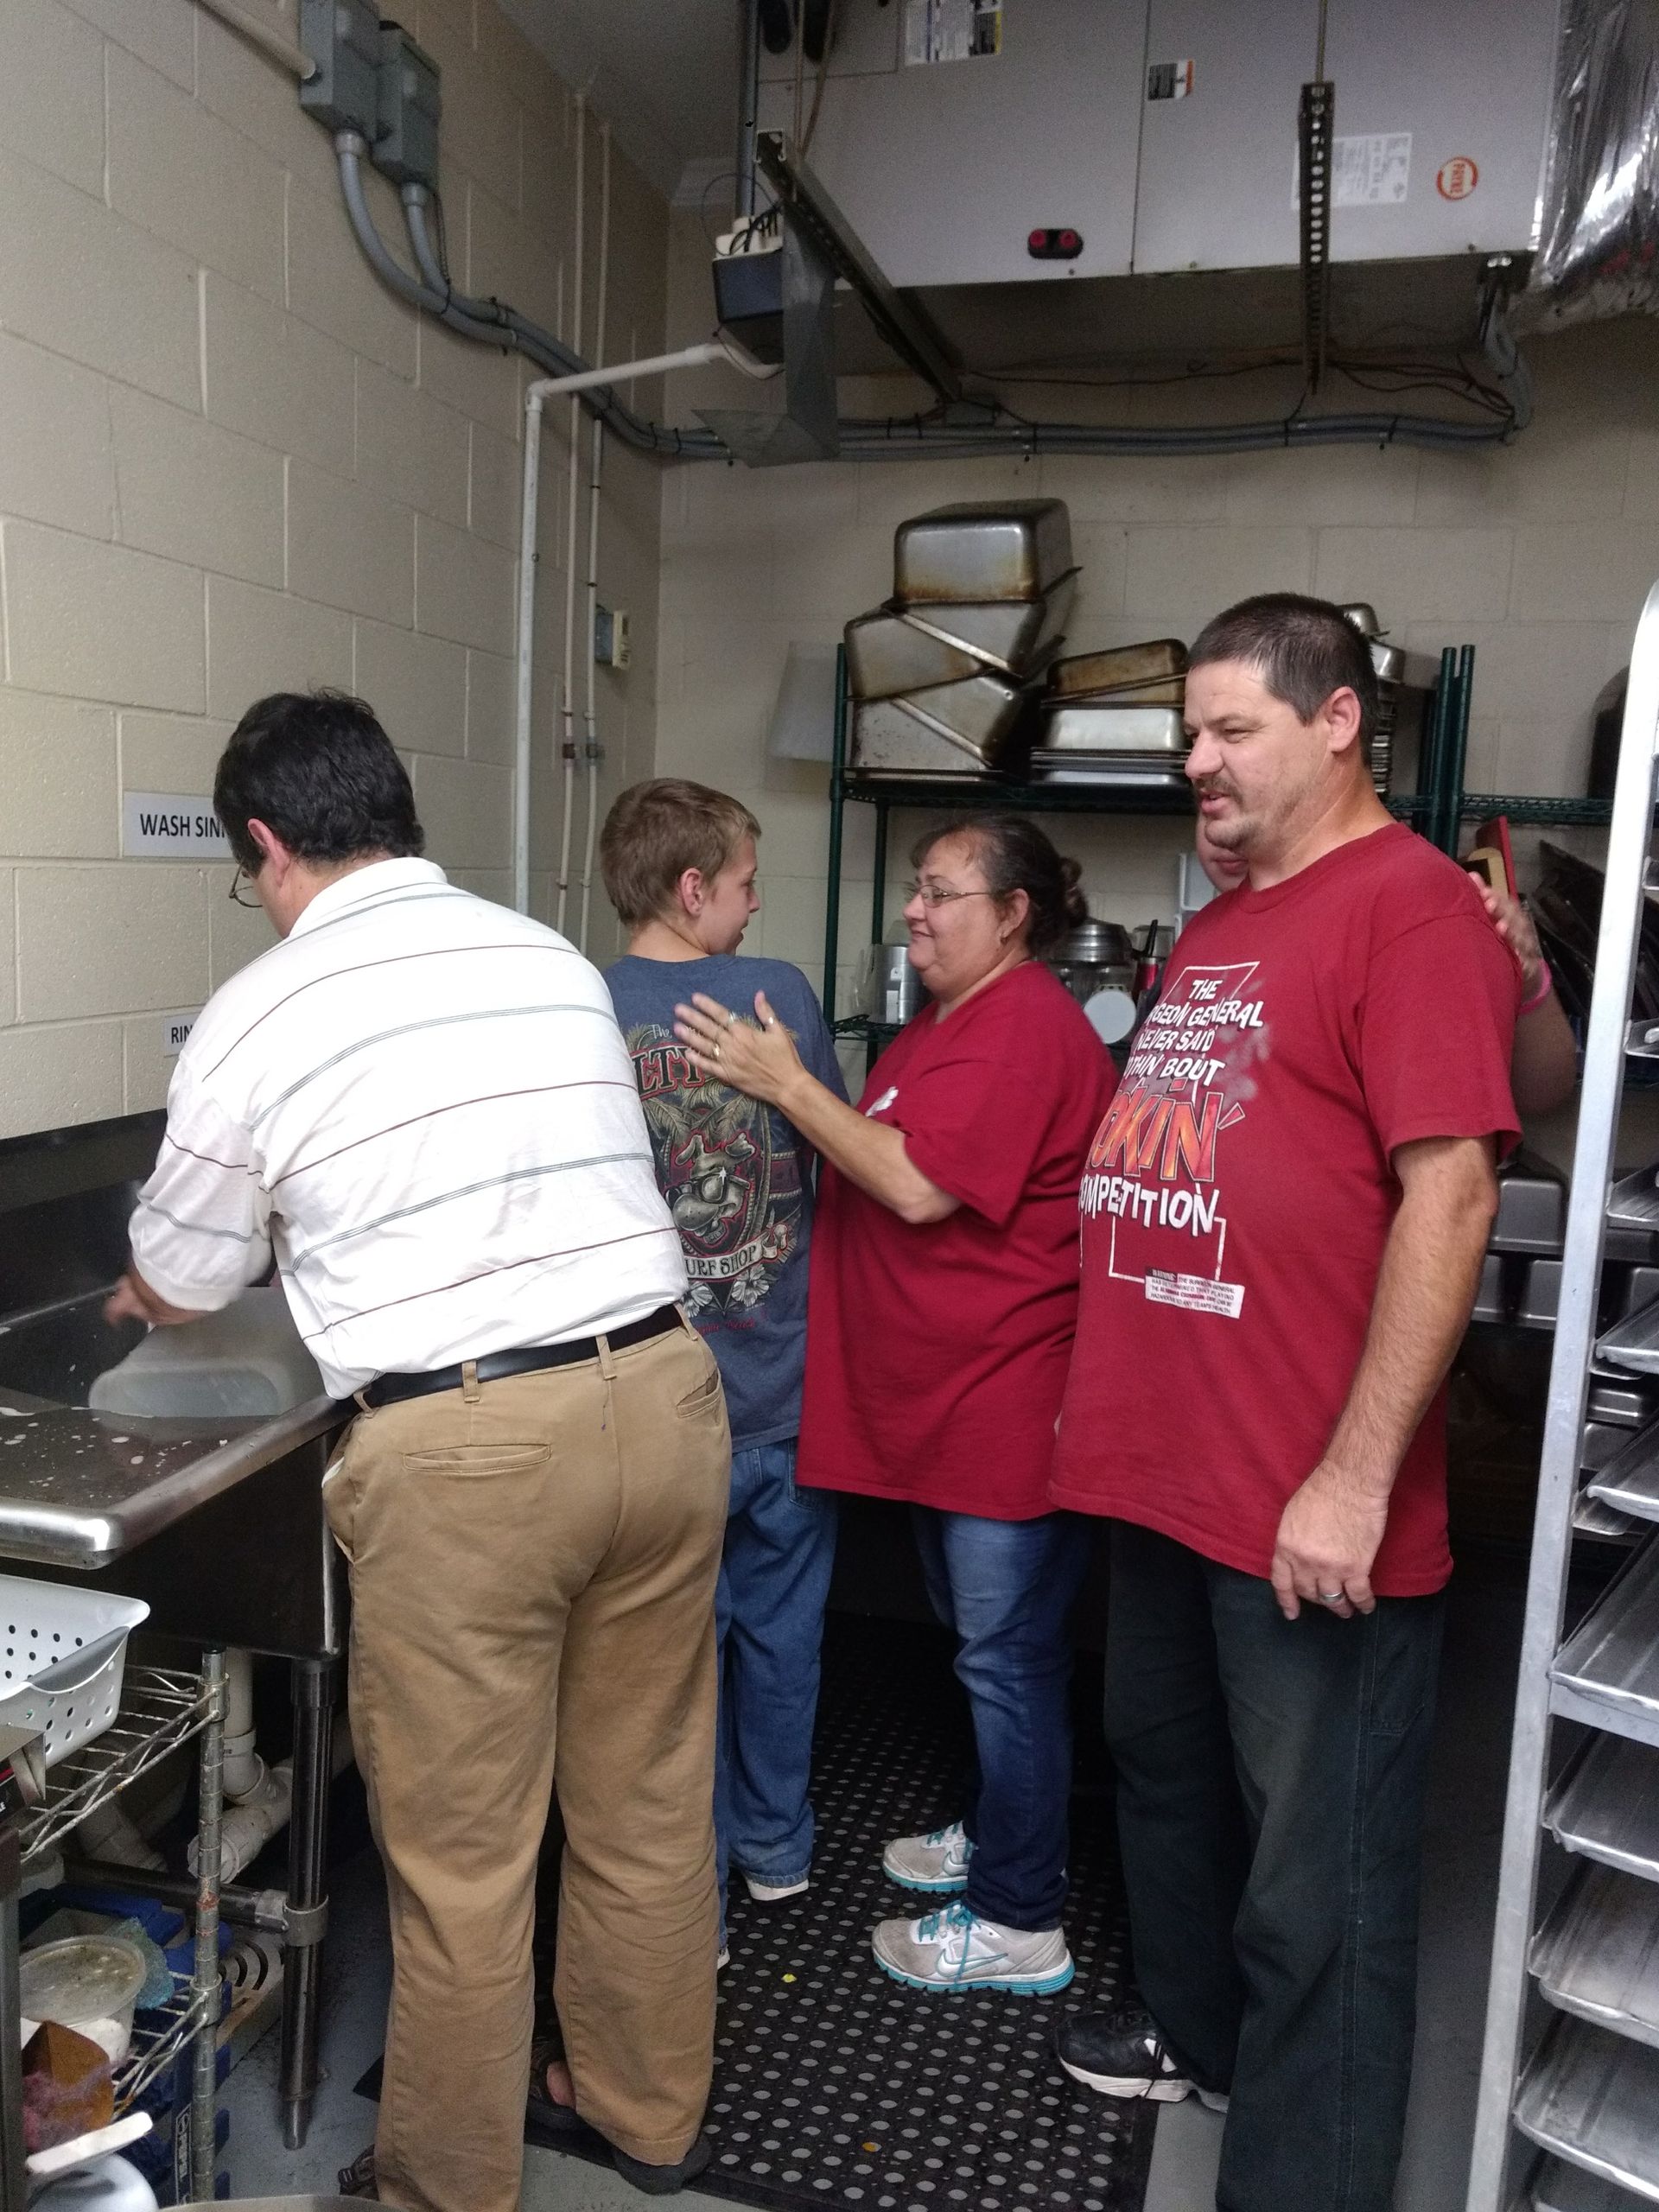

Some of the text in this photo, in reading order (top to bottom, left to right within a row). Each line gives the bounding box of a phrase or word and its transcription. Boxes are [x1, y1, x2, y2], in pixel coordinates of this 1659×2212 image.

[140, 813, 225, 838] WASH SIN
[1189, 979, 1223, 1000] THE
[1187, 997, 1264, 1029] GENERAL
[1135, 1027, 1216, 1052] NEVER SAID
[1159, 1057, 1225, 1086] BOUT
[1085, 1077, 1245, 1183] OKIN'
[1078, 1173, 1219, 1236] OMPETITION
[720, 1245, 756, 1274] SHOP
